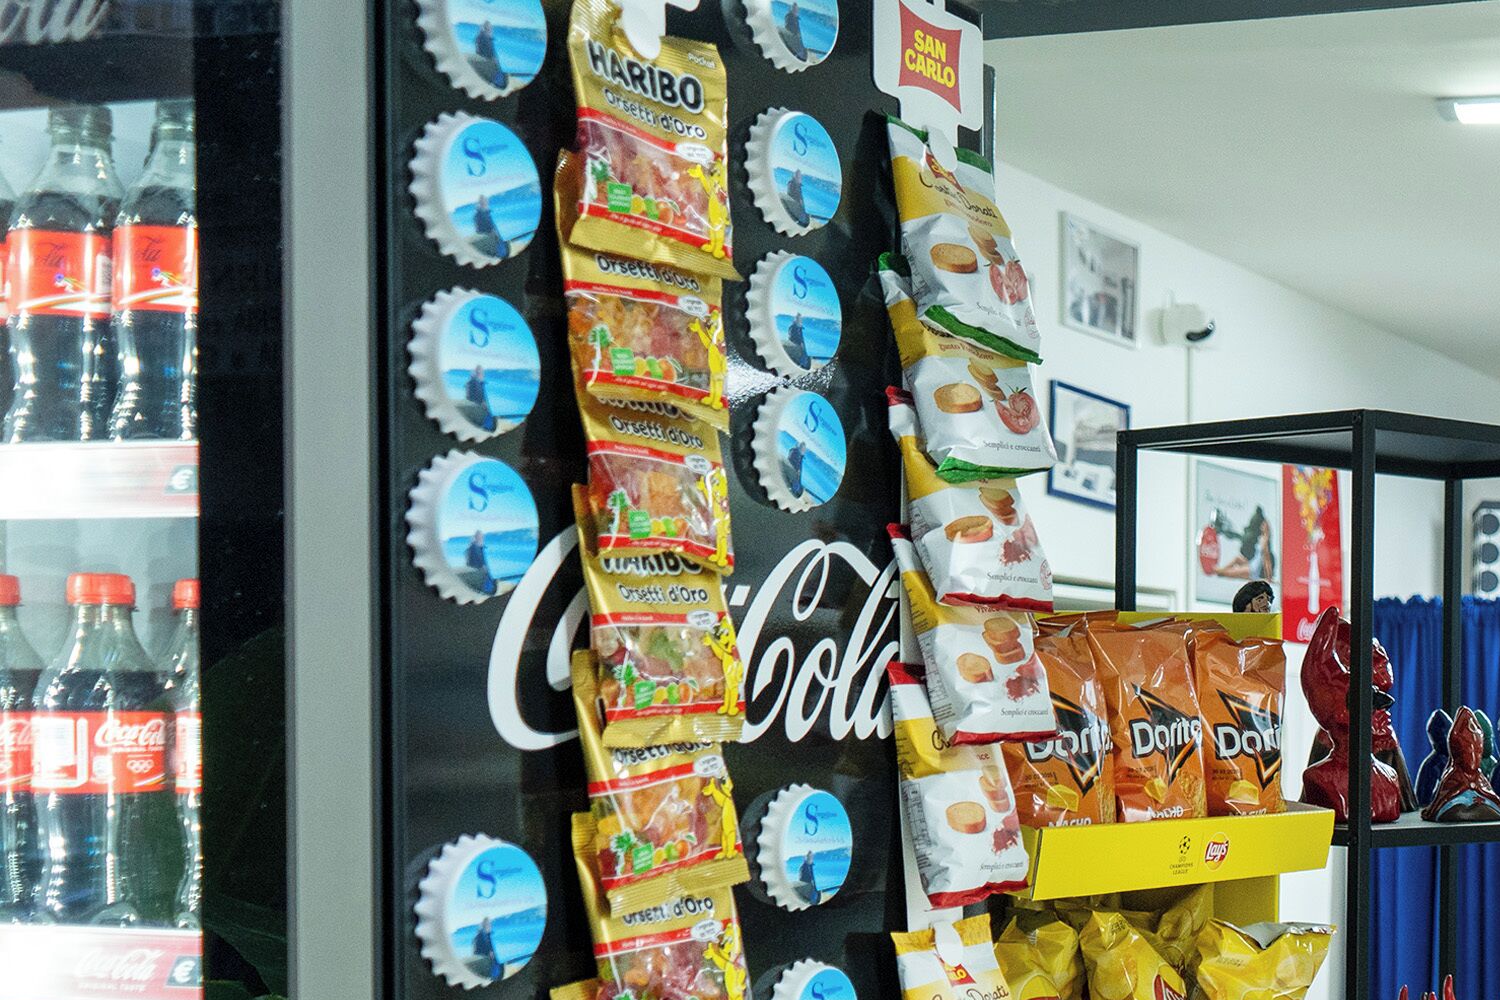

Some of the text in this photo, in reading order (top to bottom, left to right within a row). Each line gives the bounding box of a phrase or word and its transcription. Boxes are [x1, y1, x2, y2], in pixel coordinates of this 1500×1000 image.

[913, 28, 947, 62] SAN
[586, 38, 704, 113] HARIBO
[904, 52, 956, 89] CARLO
[603, 87, 657, 127] Orsetti
[660, 113, 707, 140] d'Oro
[595, 253, 659, 284] Orsetti
[608, 415, 668, 442] Orsetti
[667, 427, 705, 449] d'Oro
[617, 582, 709, 605] Orsetti d'Oro
